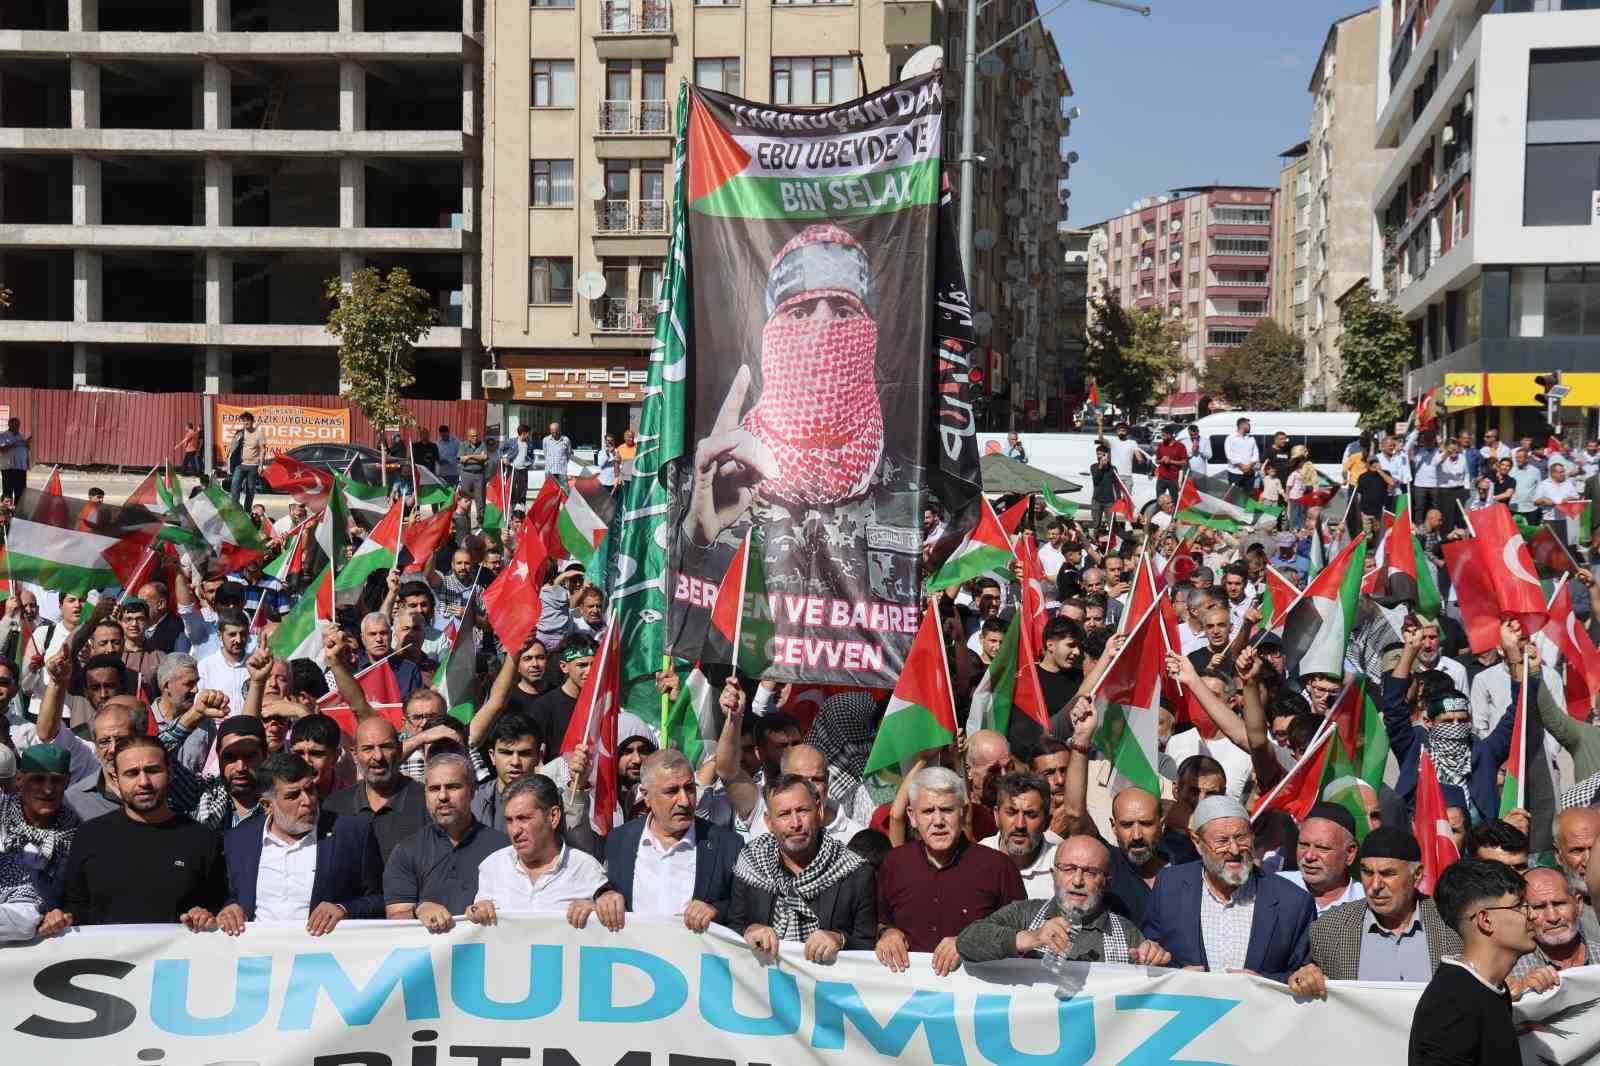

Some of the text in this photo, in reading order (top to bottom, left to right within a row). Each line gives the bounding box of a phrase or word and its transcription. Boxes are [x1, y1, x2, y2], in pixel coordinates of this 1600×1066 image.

[758, 142, 802, 170] EBU
[674, 573, 779, 624] BEREN
[785, 595, 823, 626] VE
[763, 634, 883, 671] CEVVEN
[13, 942, 1243, 1066] SUMUDUMUZ
